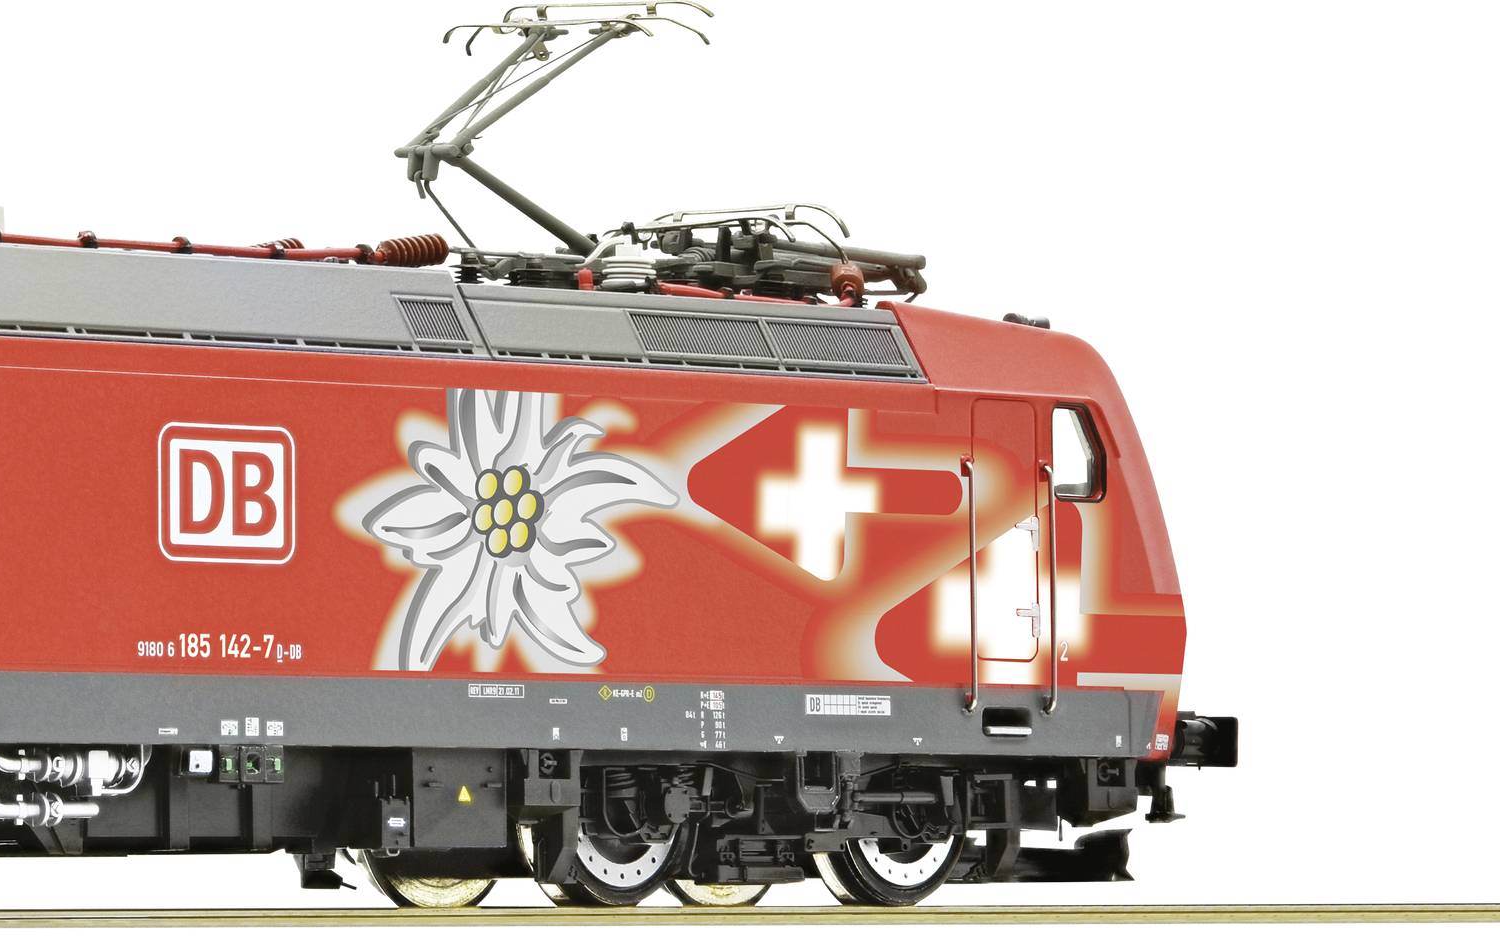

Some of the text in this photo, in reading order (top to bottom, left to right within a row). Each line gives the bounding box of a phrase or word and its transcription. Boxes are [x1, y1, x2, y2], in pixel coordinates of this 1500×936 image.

[178, 448, 278, 537] DB
[137, 641, 164, 657] 9180
[167, 641, 175, 657] 6
[179, 633, 211, 658] 185
[219, 634, 275, 659] 142-7
[1059, 641, 1069, 662] 2
[809, 696, 821, 712] DB
